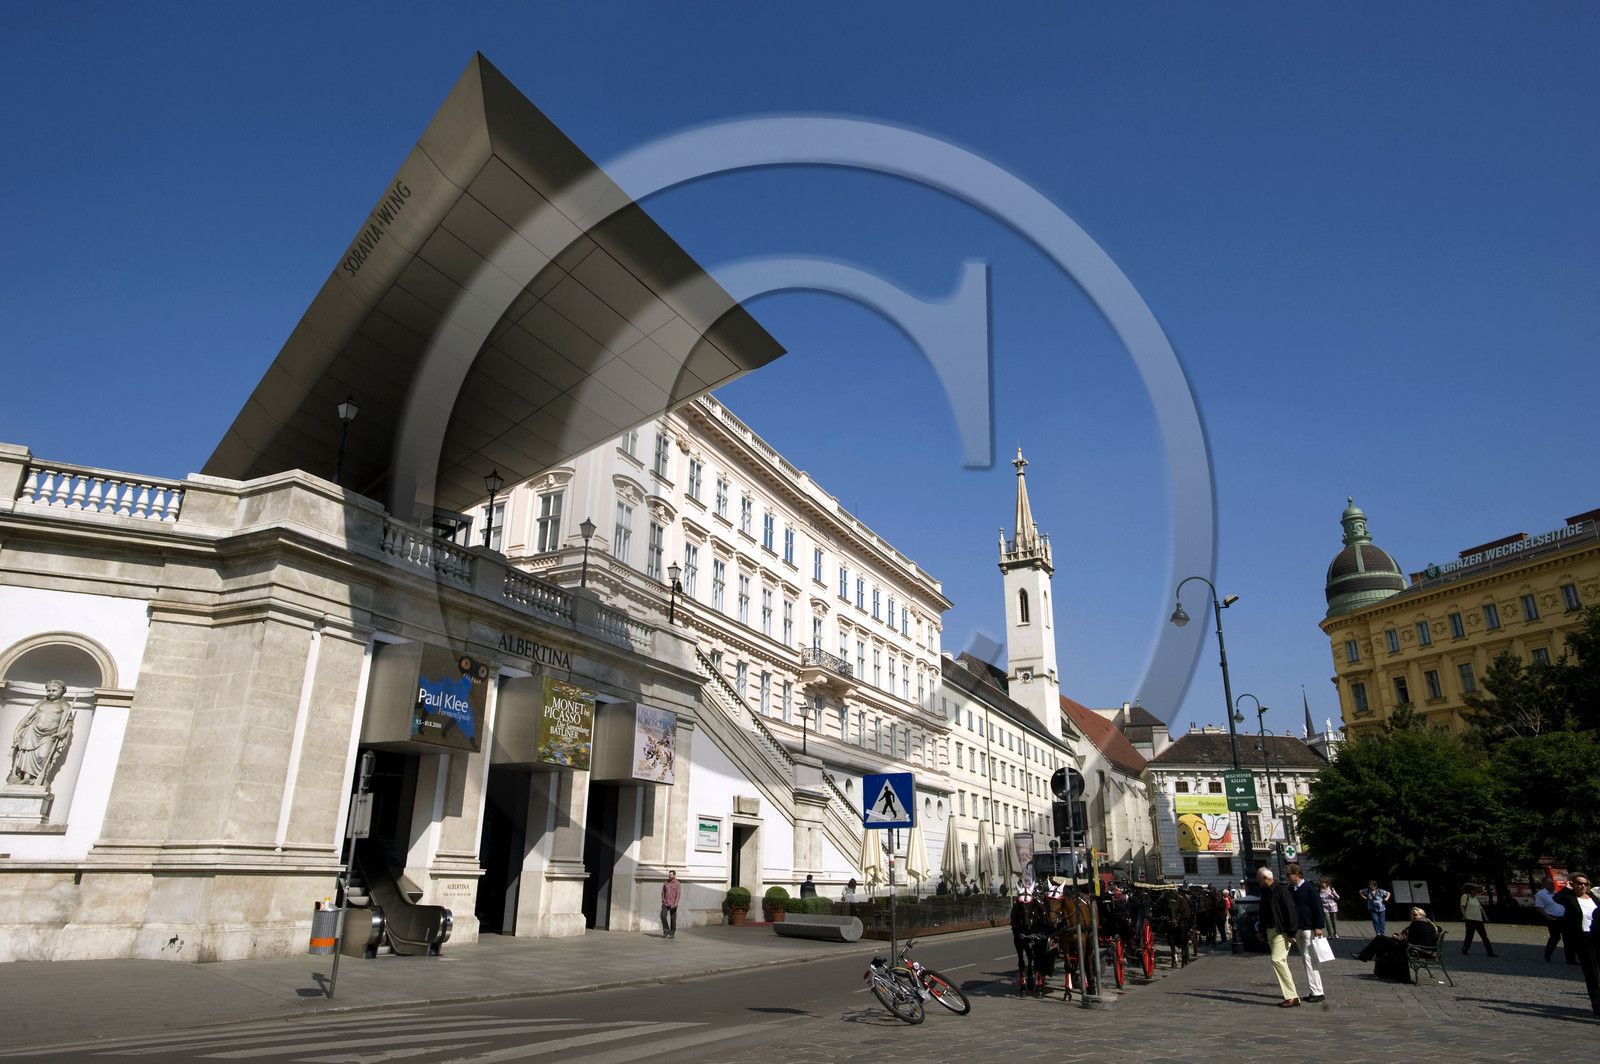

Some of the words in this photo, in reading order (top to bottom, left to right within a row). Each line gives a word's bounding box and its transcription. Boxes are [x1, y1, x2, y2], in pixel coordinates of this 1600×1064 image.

[343, 223, 384, 277] SORAVIA
[377, 181, 411, 225] WING
[1443, 552, 1483, 573] GRAZER
[1486, 522, 1583, 561] WECHSELSEITIGE
[498, 633, 571, 671] ALBERTINA
[418, 687, 443, 707] Paul
[444, 693, 469, 713] Klee
[552, 696, 585, 715] MONET
[544, 705, 581, 725] PICASSO
[550, 726, 579, 739] BATLINER
